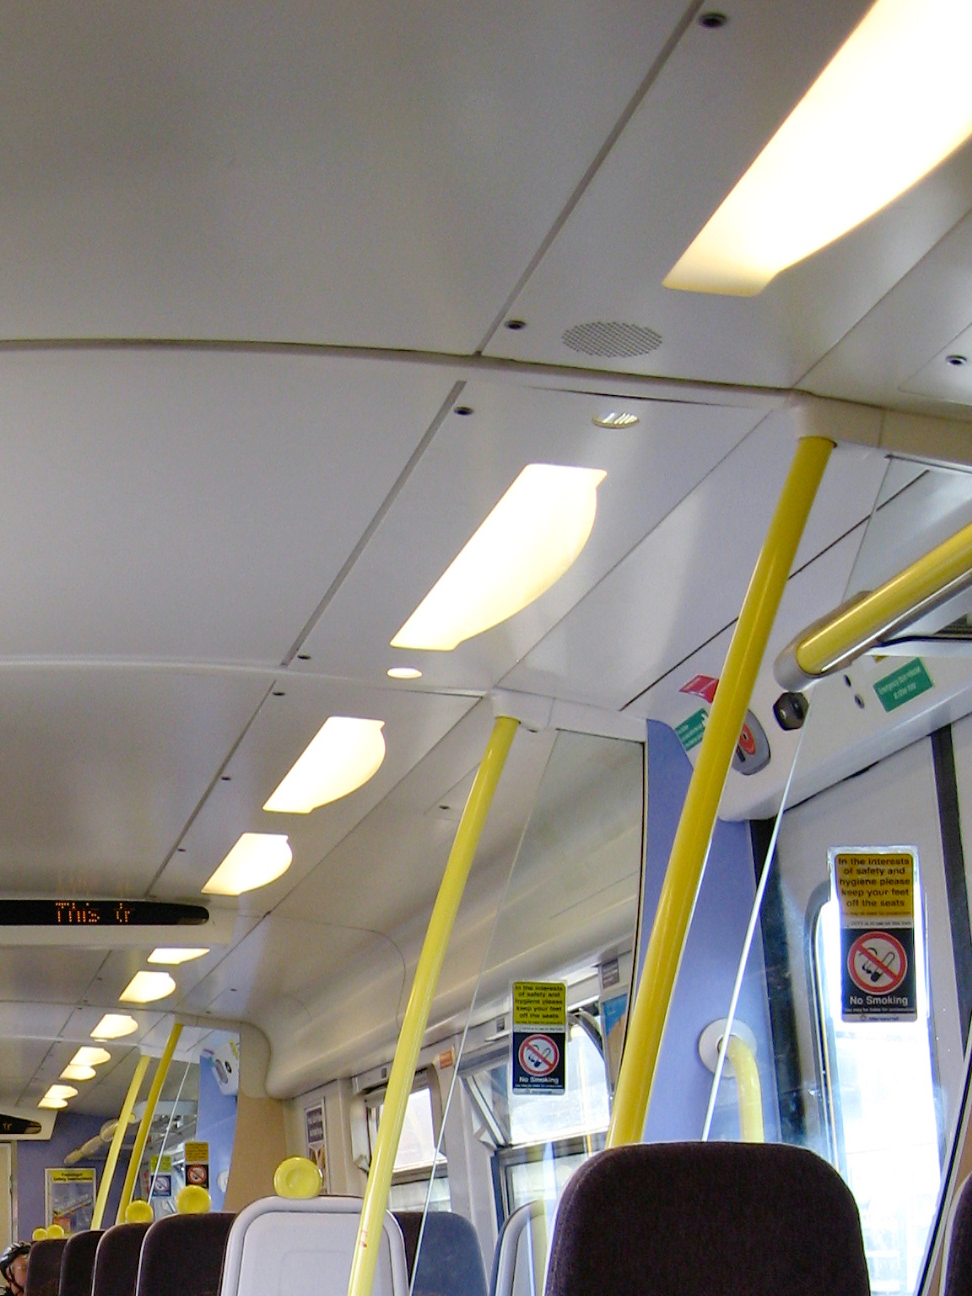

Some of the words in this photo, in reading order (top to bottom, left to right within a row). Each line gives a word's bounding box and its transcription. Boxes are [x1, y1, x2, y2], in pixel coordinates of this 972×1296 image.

[856, 867, 884, 876] safety
[840, 878, 876, 887] hygiene
[880, 878, 910, 886] please
[841, 889, 864, 897] keep
[867, 890, 888, 898] your
[850, 996, 863, 1005] No
[866, 996, 908, 1006] Smoking
[530, 1077, 559, 1085] Smoking
